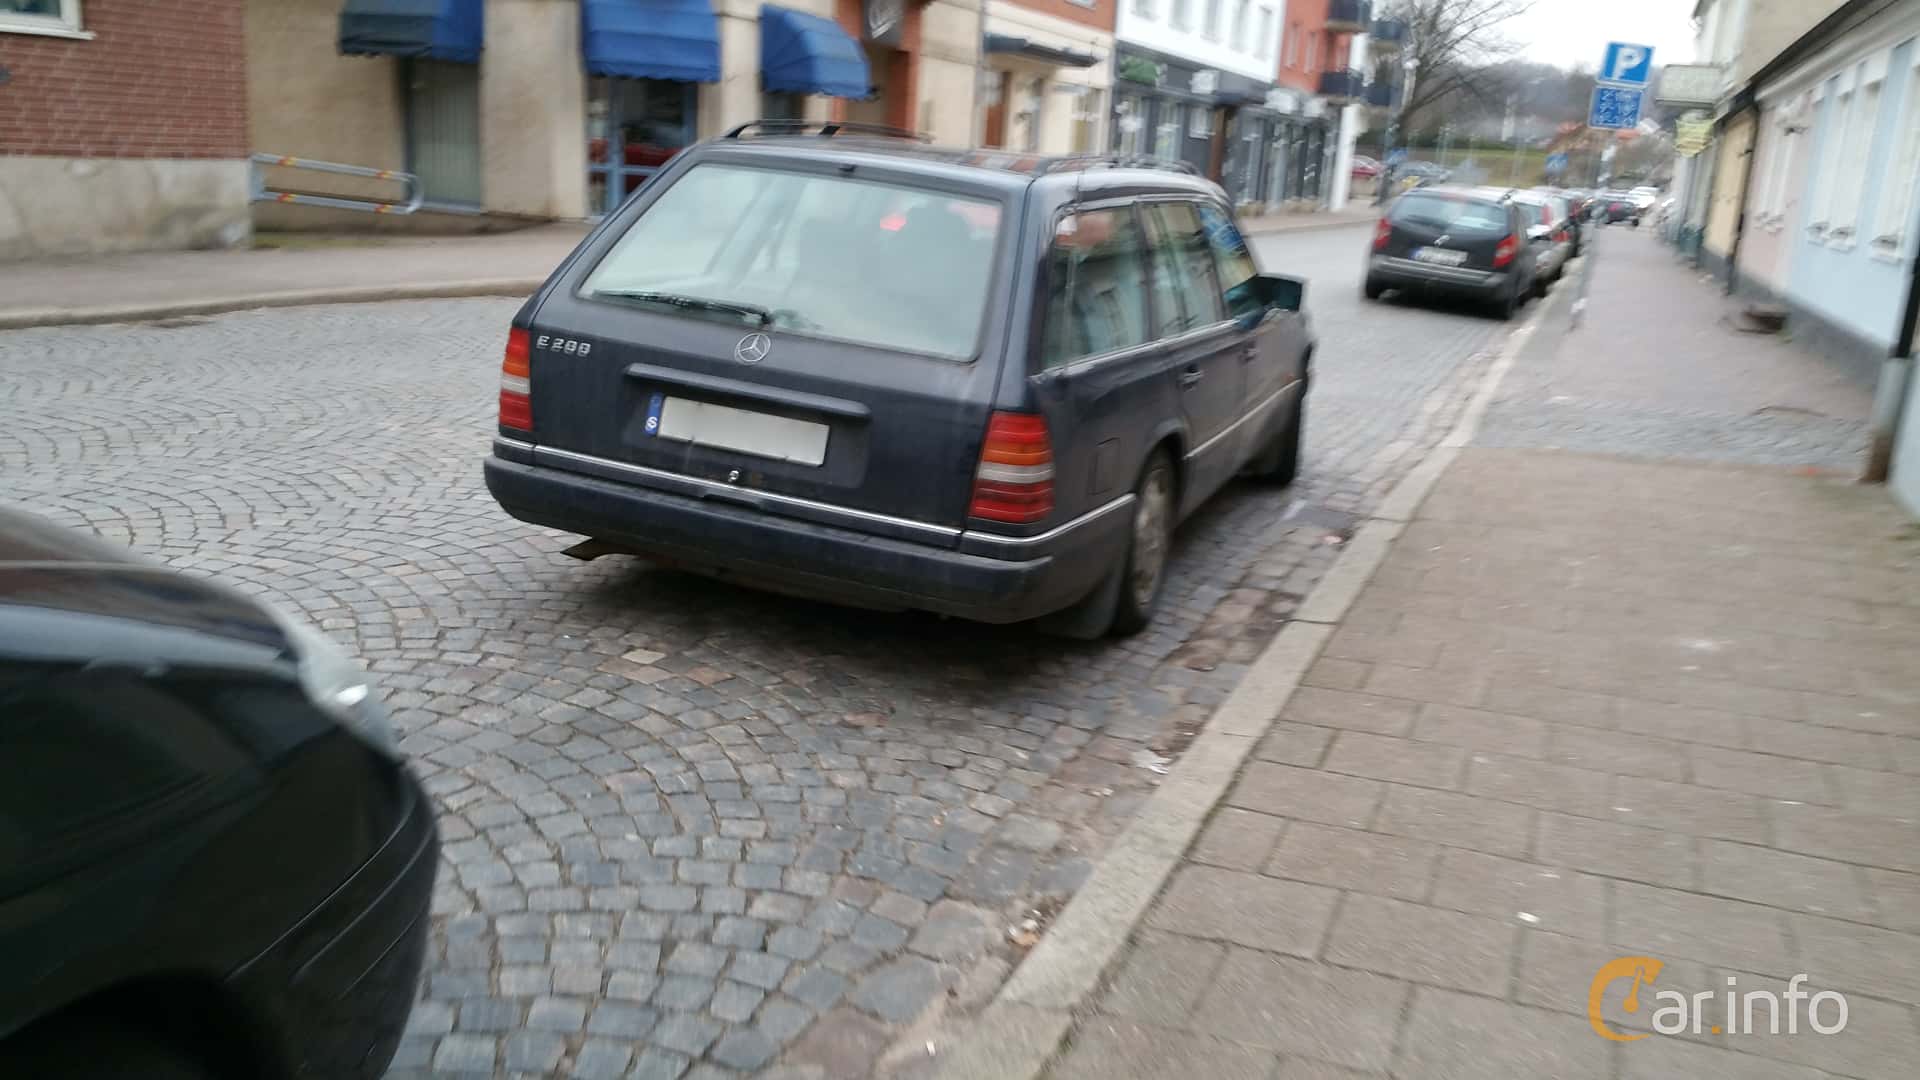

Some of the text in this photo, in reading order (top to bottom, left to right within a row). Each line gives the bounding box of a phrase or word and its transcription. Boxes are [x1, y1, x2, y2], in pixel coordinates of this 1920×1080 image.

[1611, 48, 1646, 81] P
[536, 335, 550, 349] E
[645, 416, 658, 431] S
